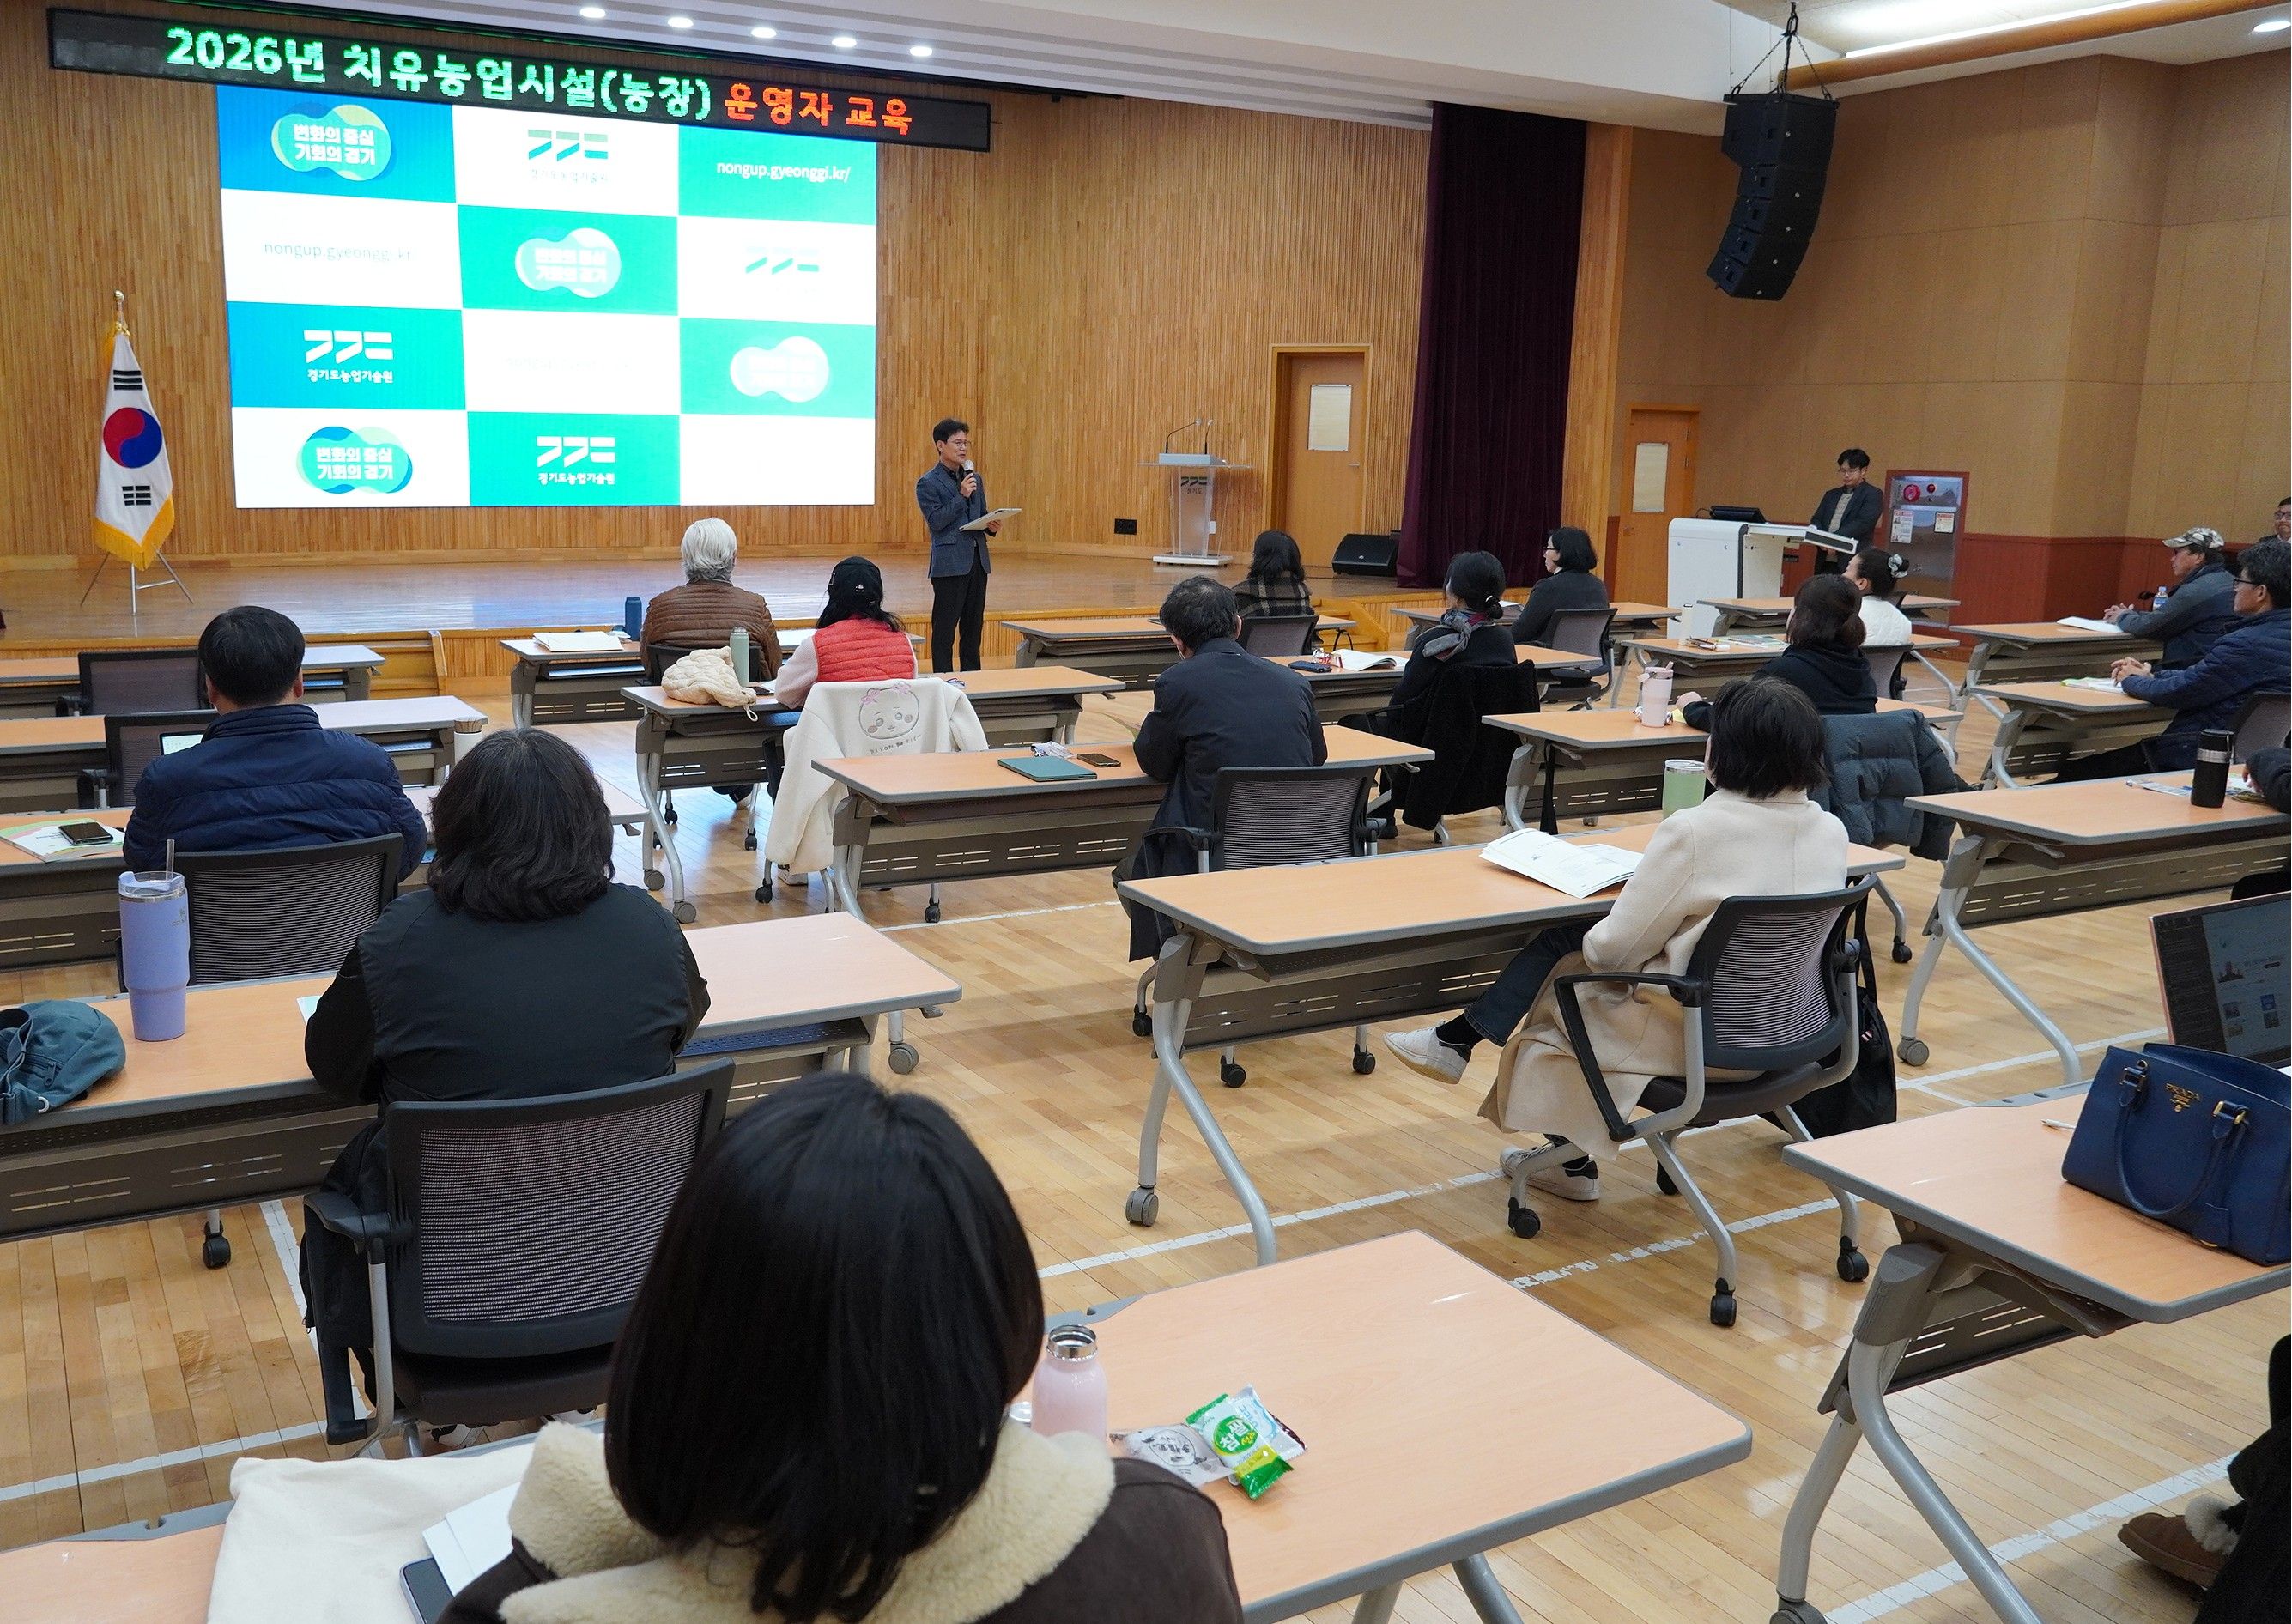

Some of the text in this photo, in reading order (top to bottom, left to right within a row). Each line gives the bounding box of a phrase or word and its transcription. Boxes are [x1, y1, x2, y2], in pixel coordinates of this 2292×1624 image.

[167, 27, 913, 136] 2026년 치유농업시설(농장) 운영자 교육
[294, 124, 375, 146] 변화의 중심
[294, 143, 376, 166] 기회의 경기
[716, 161, 852, 184] nongup.gyeonggi.kr/
[306, 368, 394, 385] 경기도농업기술원
[316, 446, 393, 464] 변화의 중심
[317, 464, 394, 482] 기회의 경기
[537, 472, 616, 487] 경기도농업기술원
[2165, 1082, 2201, 1101] PRADA
